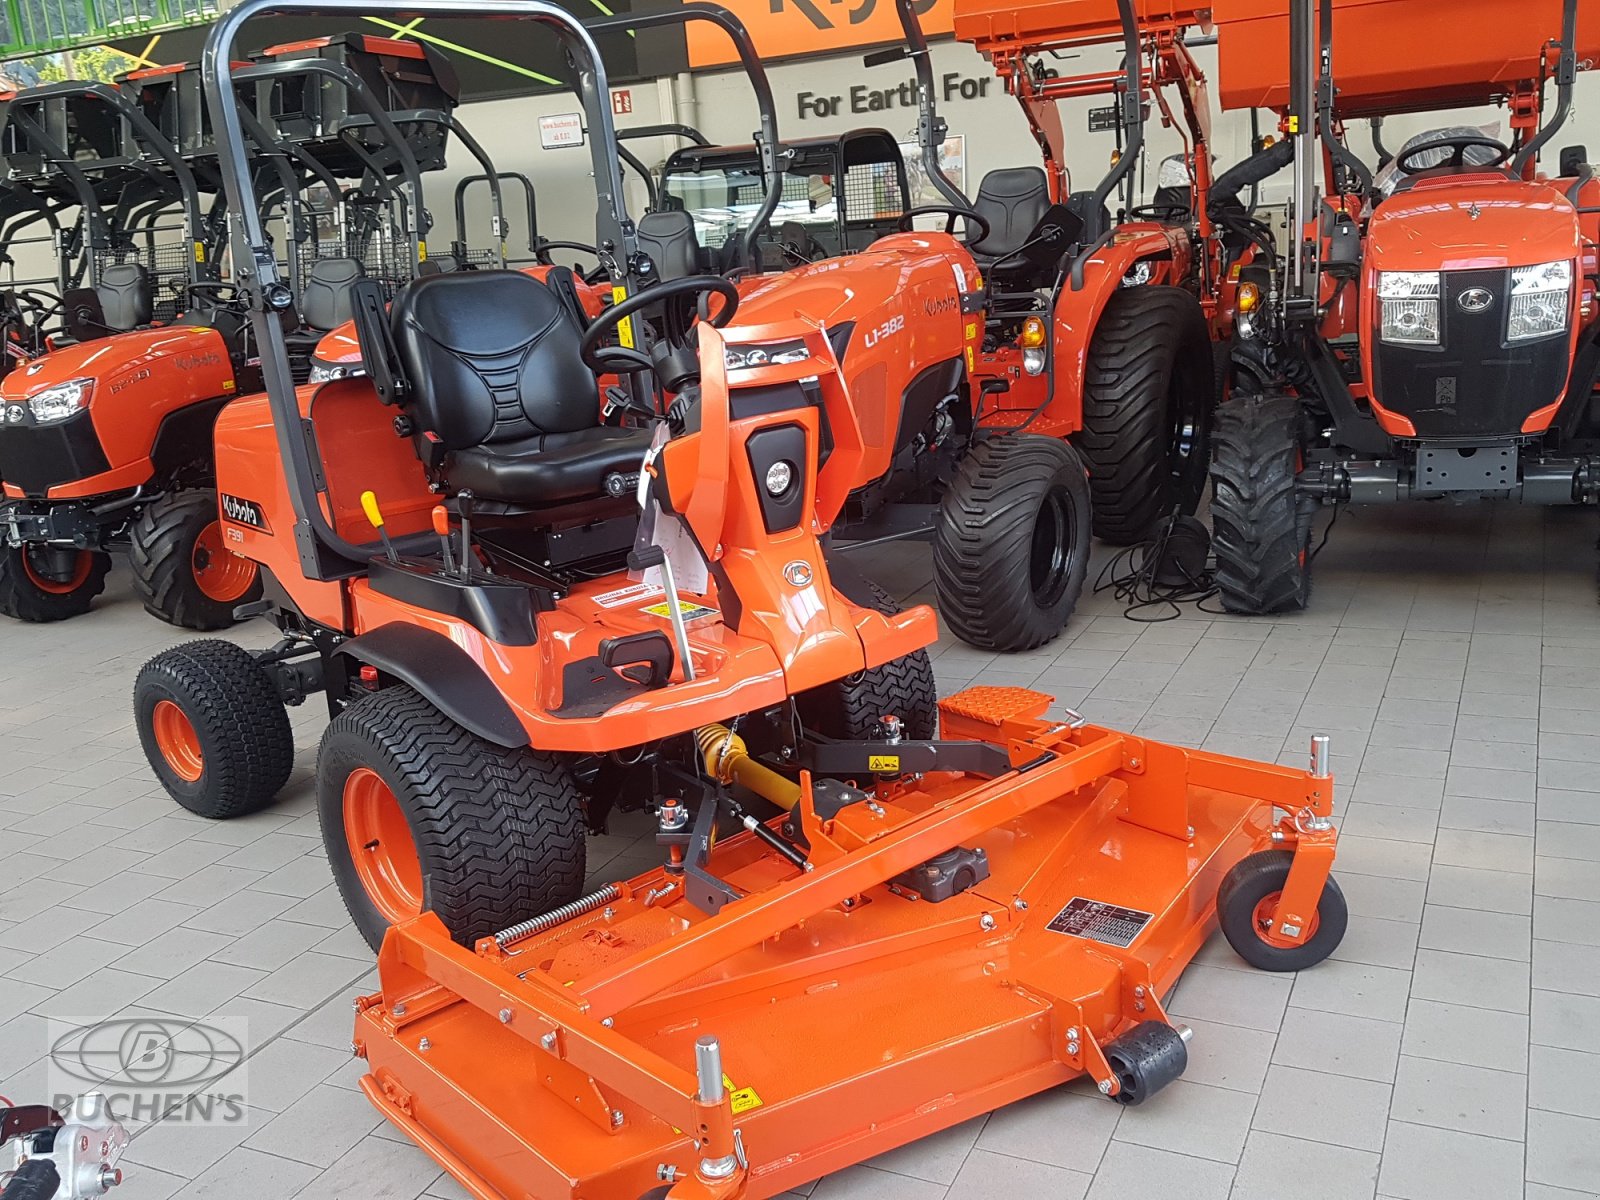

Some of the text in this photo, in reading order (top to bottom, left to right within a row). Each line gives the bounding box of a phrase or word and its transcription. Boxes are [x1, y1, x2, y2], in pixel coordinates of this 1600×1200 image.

[797, 91, 842, 119] For
[943, 72, 990, 101] For
[924, 296, 957, 317] Kubota
[864, 315, 905, 348] L1-382
[222, 494, 257, 525] Kubota
